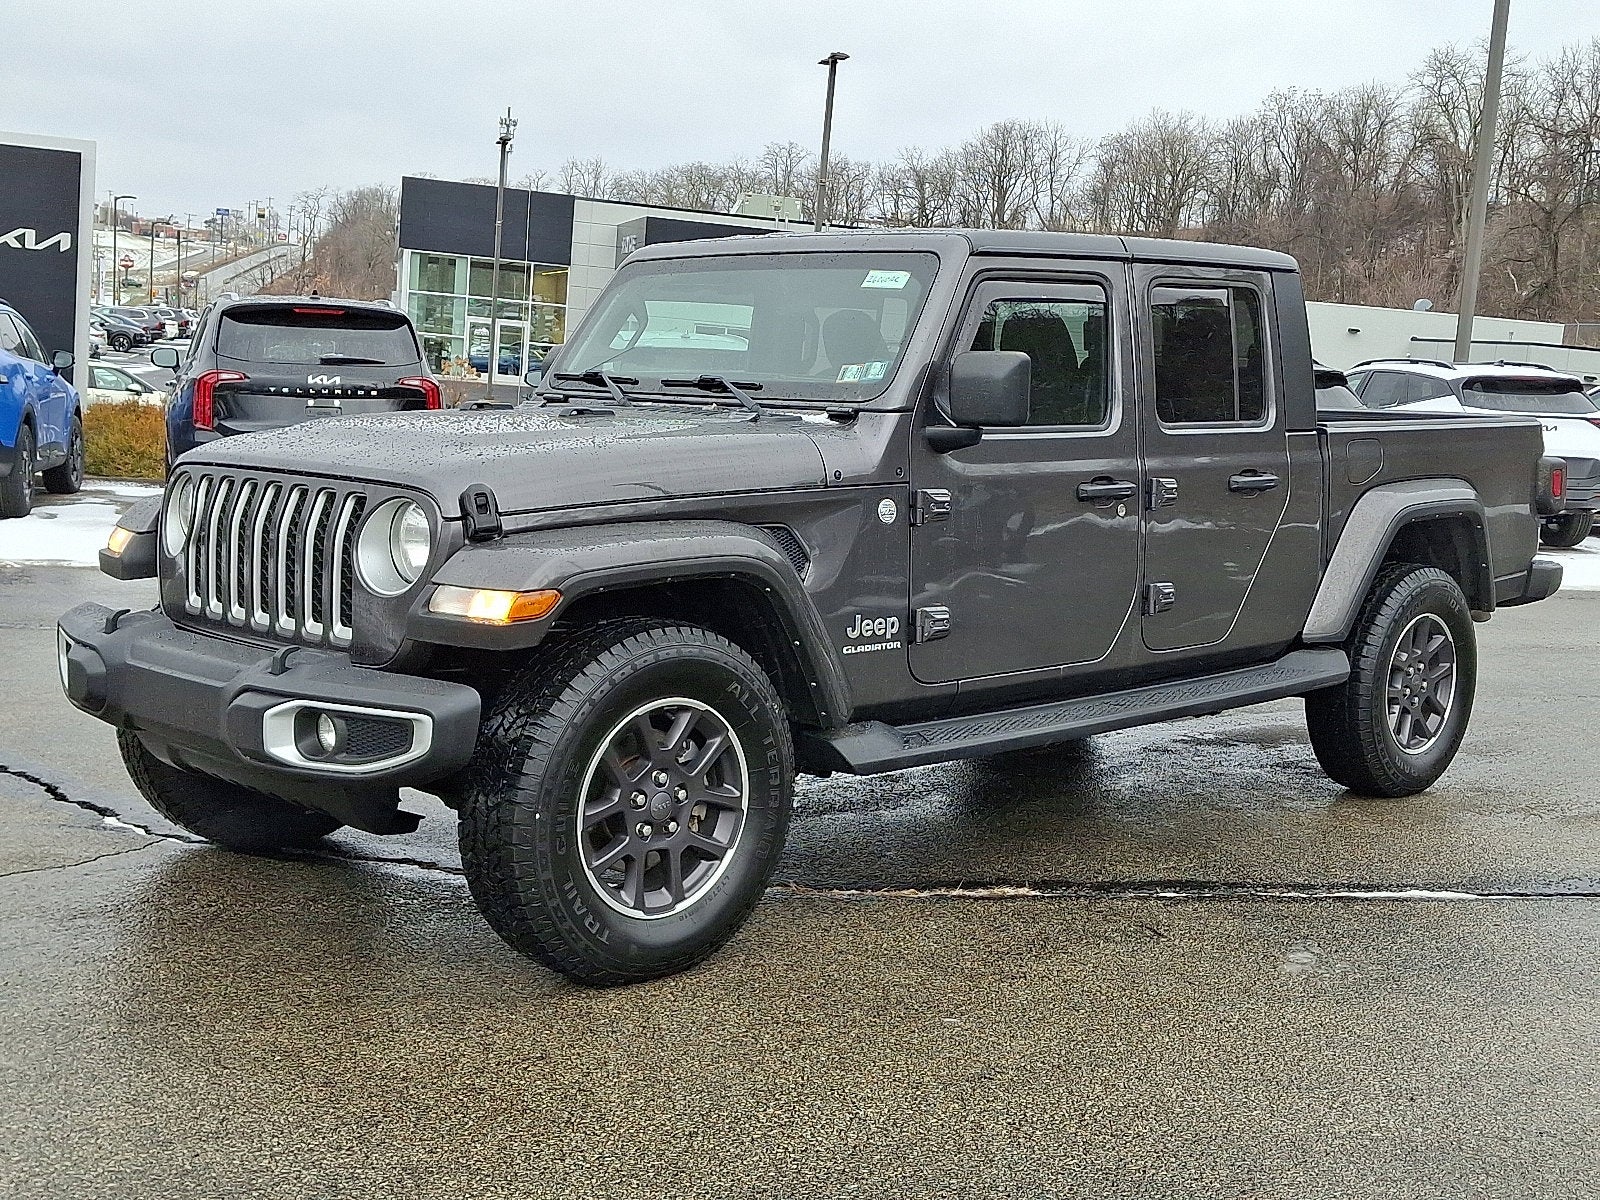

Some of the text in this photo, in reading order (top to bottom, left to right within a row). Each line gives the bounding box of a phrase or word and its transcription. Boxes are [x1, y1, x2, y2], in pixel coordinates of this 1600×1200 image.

[307, 375, 340, 385] KIA
[268, 387, 378, 396] TELLURIDE
[846, 614, 900, 639] Jeep
[842, 641, 902, 655] GLADIATOR
[725, 680, 759, 721] ALL
[562, 870, 610, 945] TRAIL
